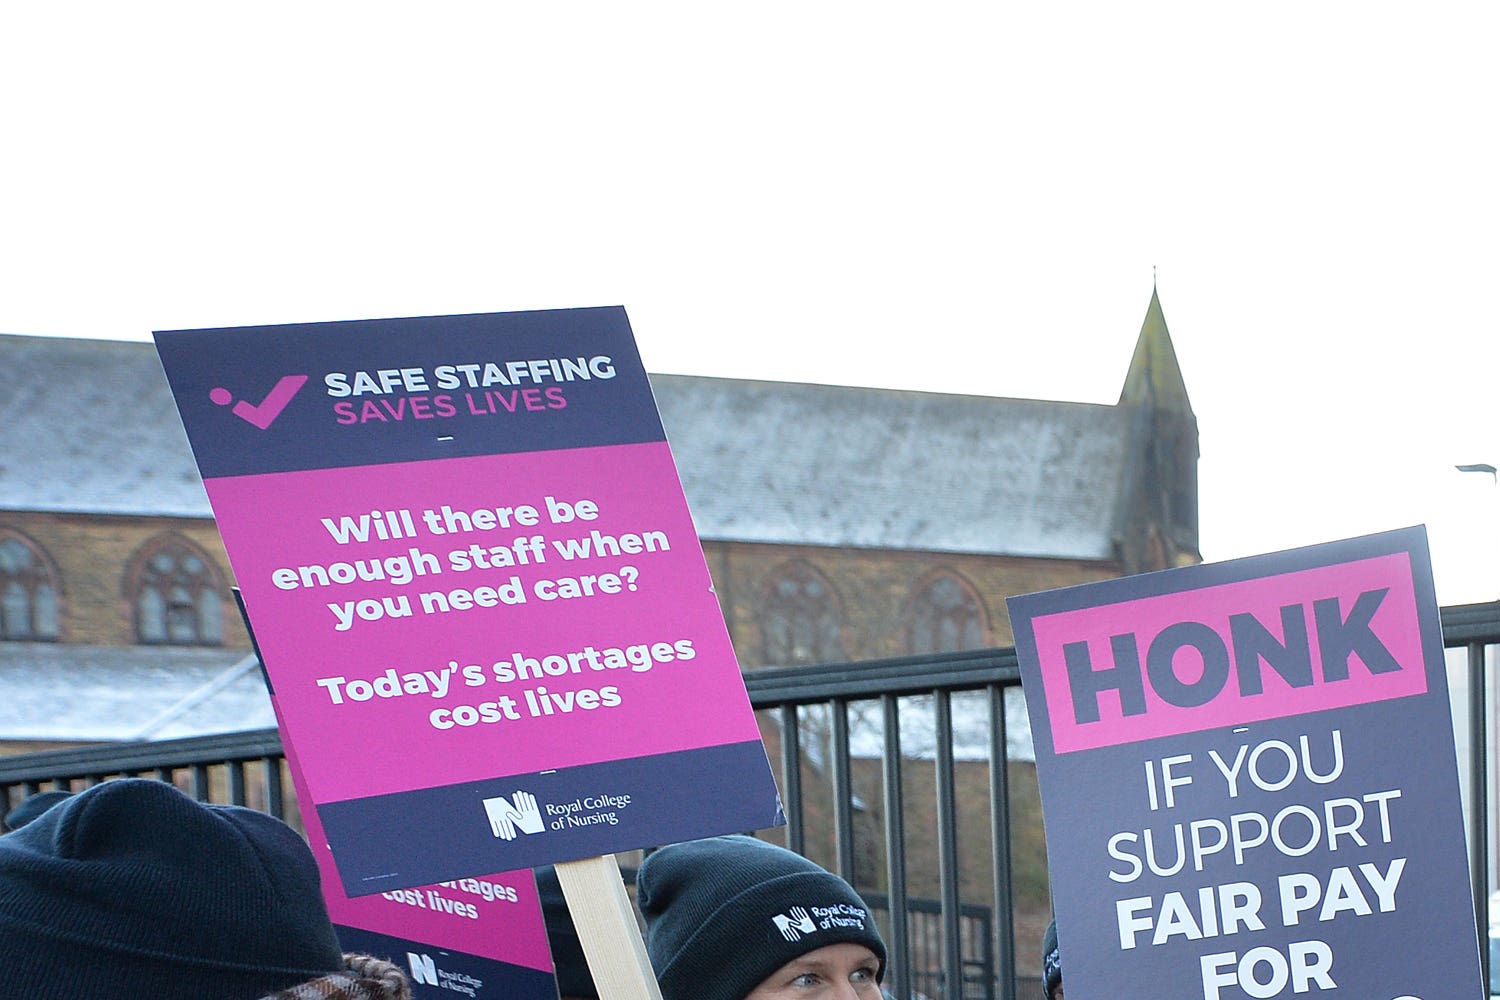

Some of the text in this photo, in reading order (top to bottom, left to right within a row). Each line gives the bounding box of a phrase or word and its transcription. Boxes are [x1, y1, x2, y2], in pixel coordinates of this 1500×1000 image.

[324, 356, 616, 397] SAFE STAFFING
[333, 386, 568, 426] SAVES LIVES
[321, 497, 599, 545] Will there be
[271, 530, 671, 590] enough staff when
[327, 566, 639, 631] you need care?
[316, 639, 696, 705] Today’s shortages
[1062, 588, 1403, 725] HONK
[429, 686, 622, 730] cost lives
[1145, 730, 1344, 811] IF YOU
[546, 794, 632, 817] Royal College
[551, 811, 619, 831] of Nursing
[1108, 790, 1402, 883] SUPPORT
[427, 890, 479, 919] lives
[811, 904, 840, 918] Royal
[820, 918, 832, 930] of
[1116, 858, 1407, 950] FAIR PAY
